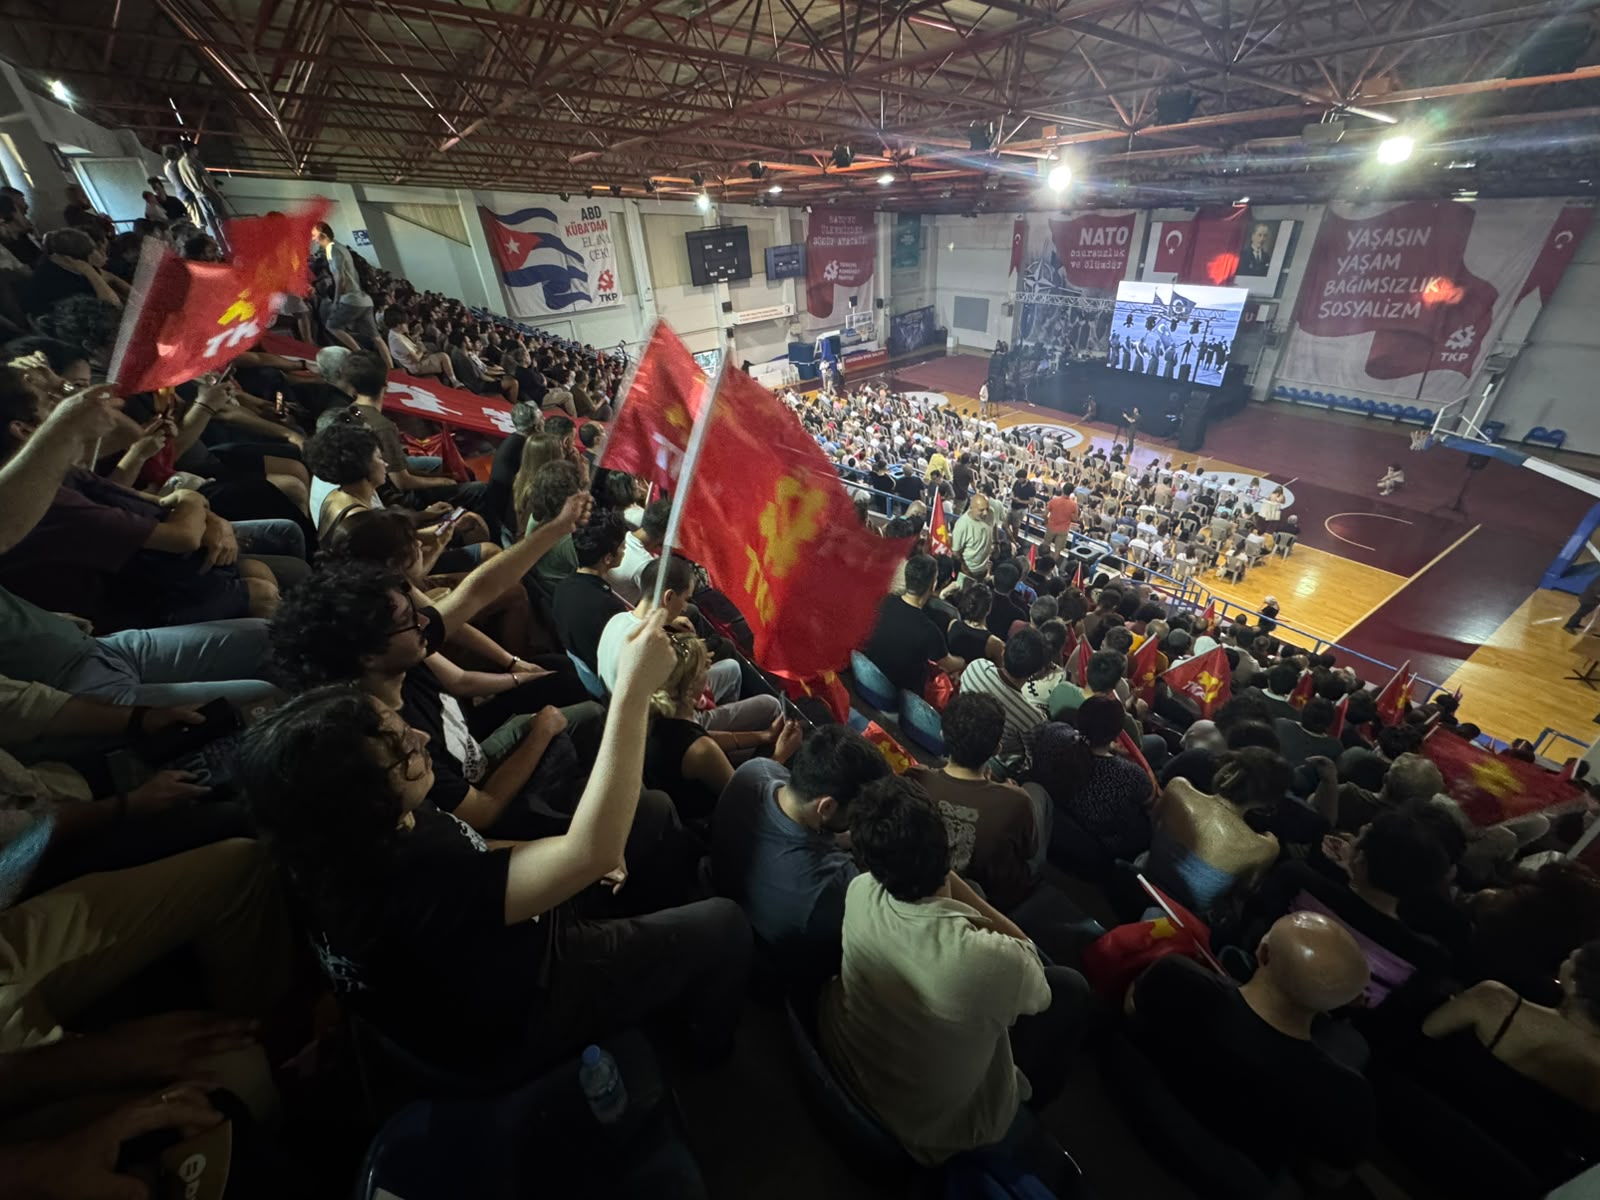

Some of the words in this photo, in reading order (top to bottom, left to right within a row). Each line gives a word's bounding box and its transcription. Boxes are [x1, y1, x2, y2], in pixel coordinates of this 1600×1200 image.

[581, 205, 602, 221] ABD
[565, 219, 608, 237] KÜBA'DAN
[1079, 226, 1129, 246] NATO
[1347, 226, 1432, 251] YAŞASIN
[1070, 248, 1126, 258] onursuzluk
[1070, 261, 1081, 269] ve
[1084, 259, 1123, 270] ölümdür
[1337, 253, 1402, 275] YAŞAM
[1323, 275, 1442, 297] BAĞIMSIZLIK
[599, 293, 618, 304] TKP
[1318, 298, 1422, 319] SOSYALİZM
[1440, 352, 1469, 362] TKP
